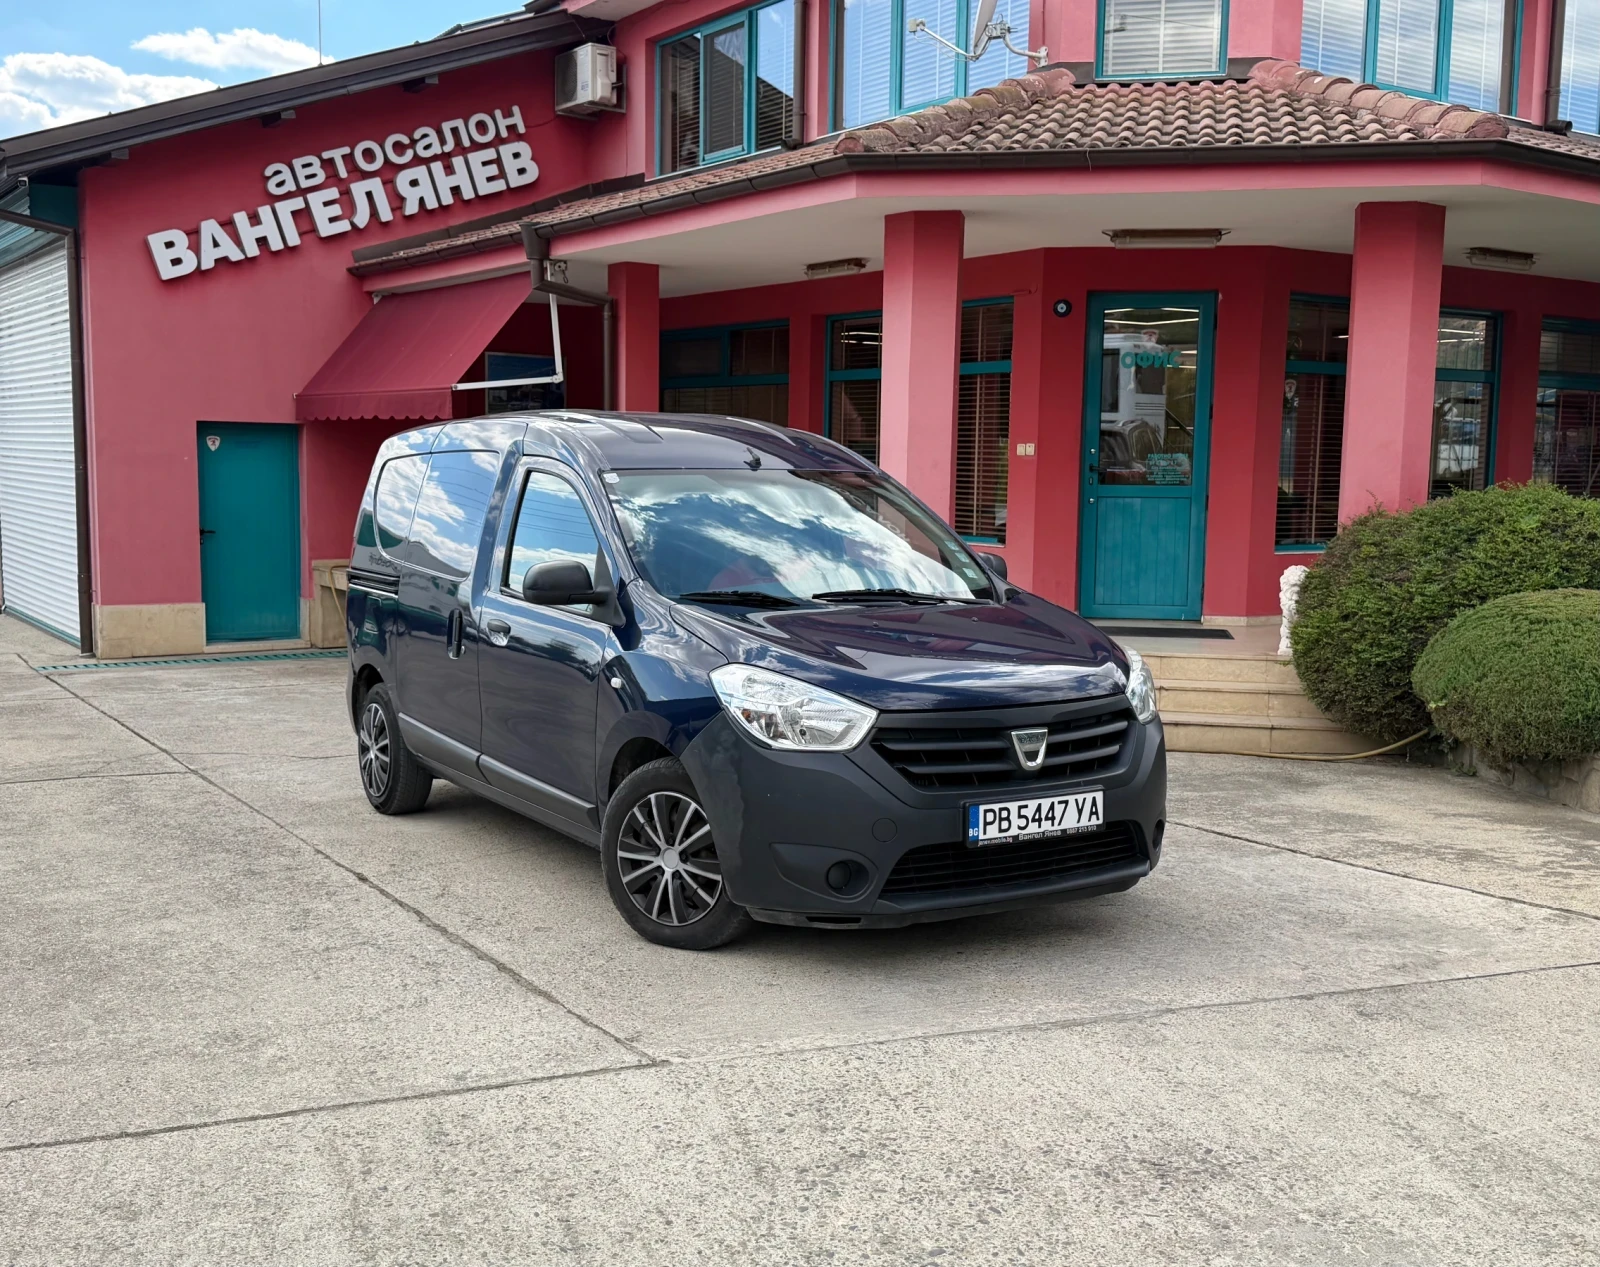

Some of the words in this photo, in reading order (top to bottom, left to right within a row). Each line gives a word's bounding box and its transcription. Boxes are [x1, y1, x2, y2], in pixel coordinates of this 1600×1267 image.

[264, 105, 526, 196] автосалон
[145, 176, 394, 281] ВАНГЕЛ
[393, 141, 540, 217] ЯНЕВ
[1120, 351, 1182, 369] ОФИС
[1017, 799, 1069, 831] 5447
[968, 828, 979, 837] BG
